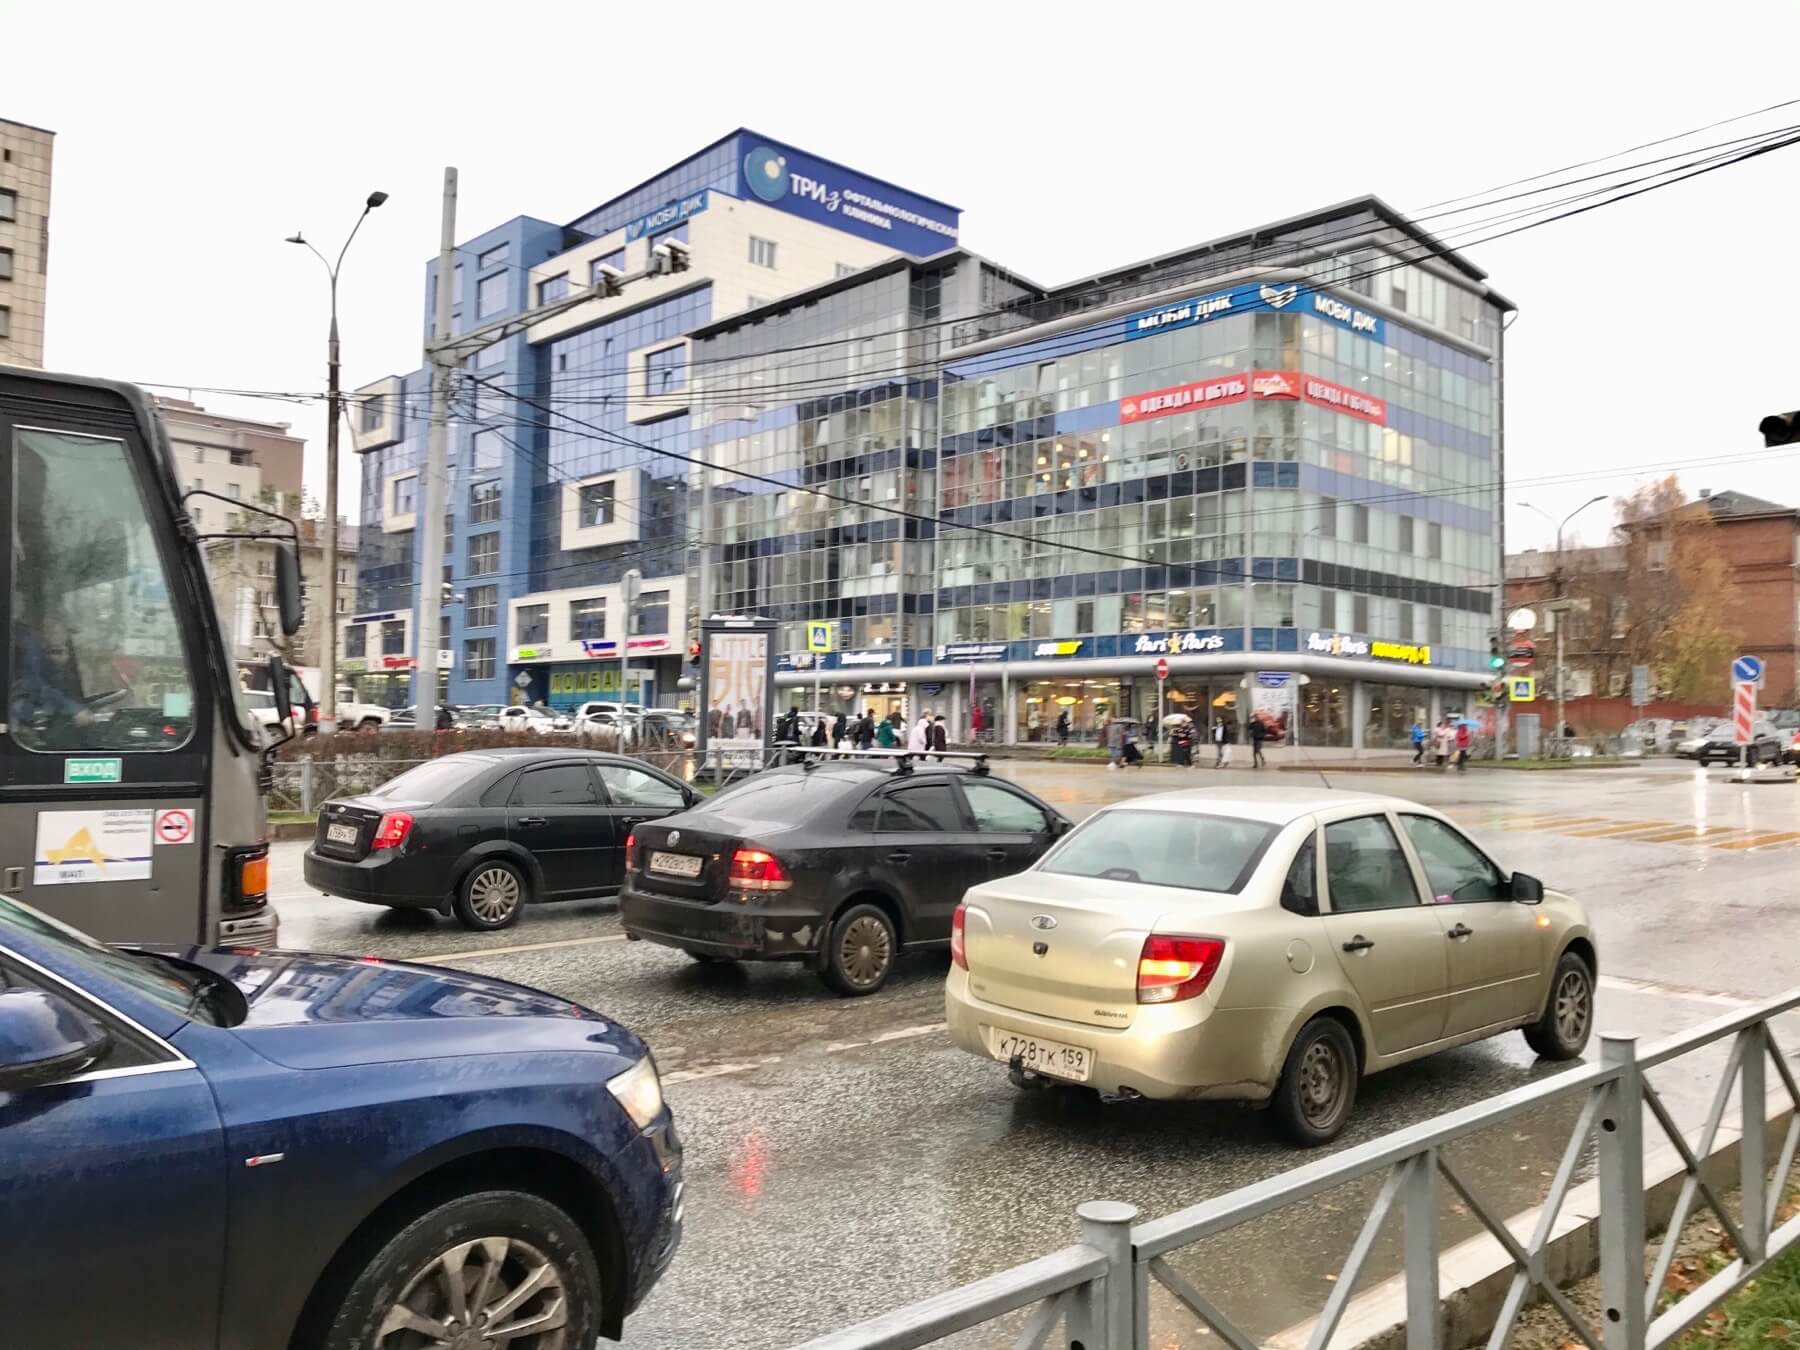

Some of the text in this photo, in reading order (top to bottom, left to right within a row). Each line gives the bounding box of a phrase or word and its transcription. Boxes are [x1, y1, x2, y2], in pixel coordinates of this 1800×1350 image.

[842, 204, 892, 230] КЛИНИКА
[1194, 294, 1233, 321] ДИК
[1315, 294, 1377, 333] МОБИ ДИК
[1139, 388, 1192, 414] ОДЕЖДА
[70, 762, 117, 779] ВХОД
[1060, 1047, 1084, 1067] 159
